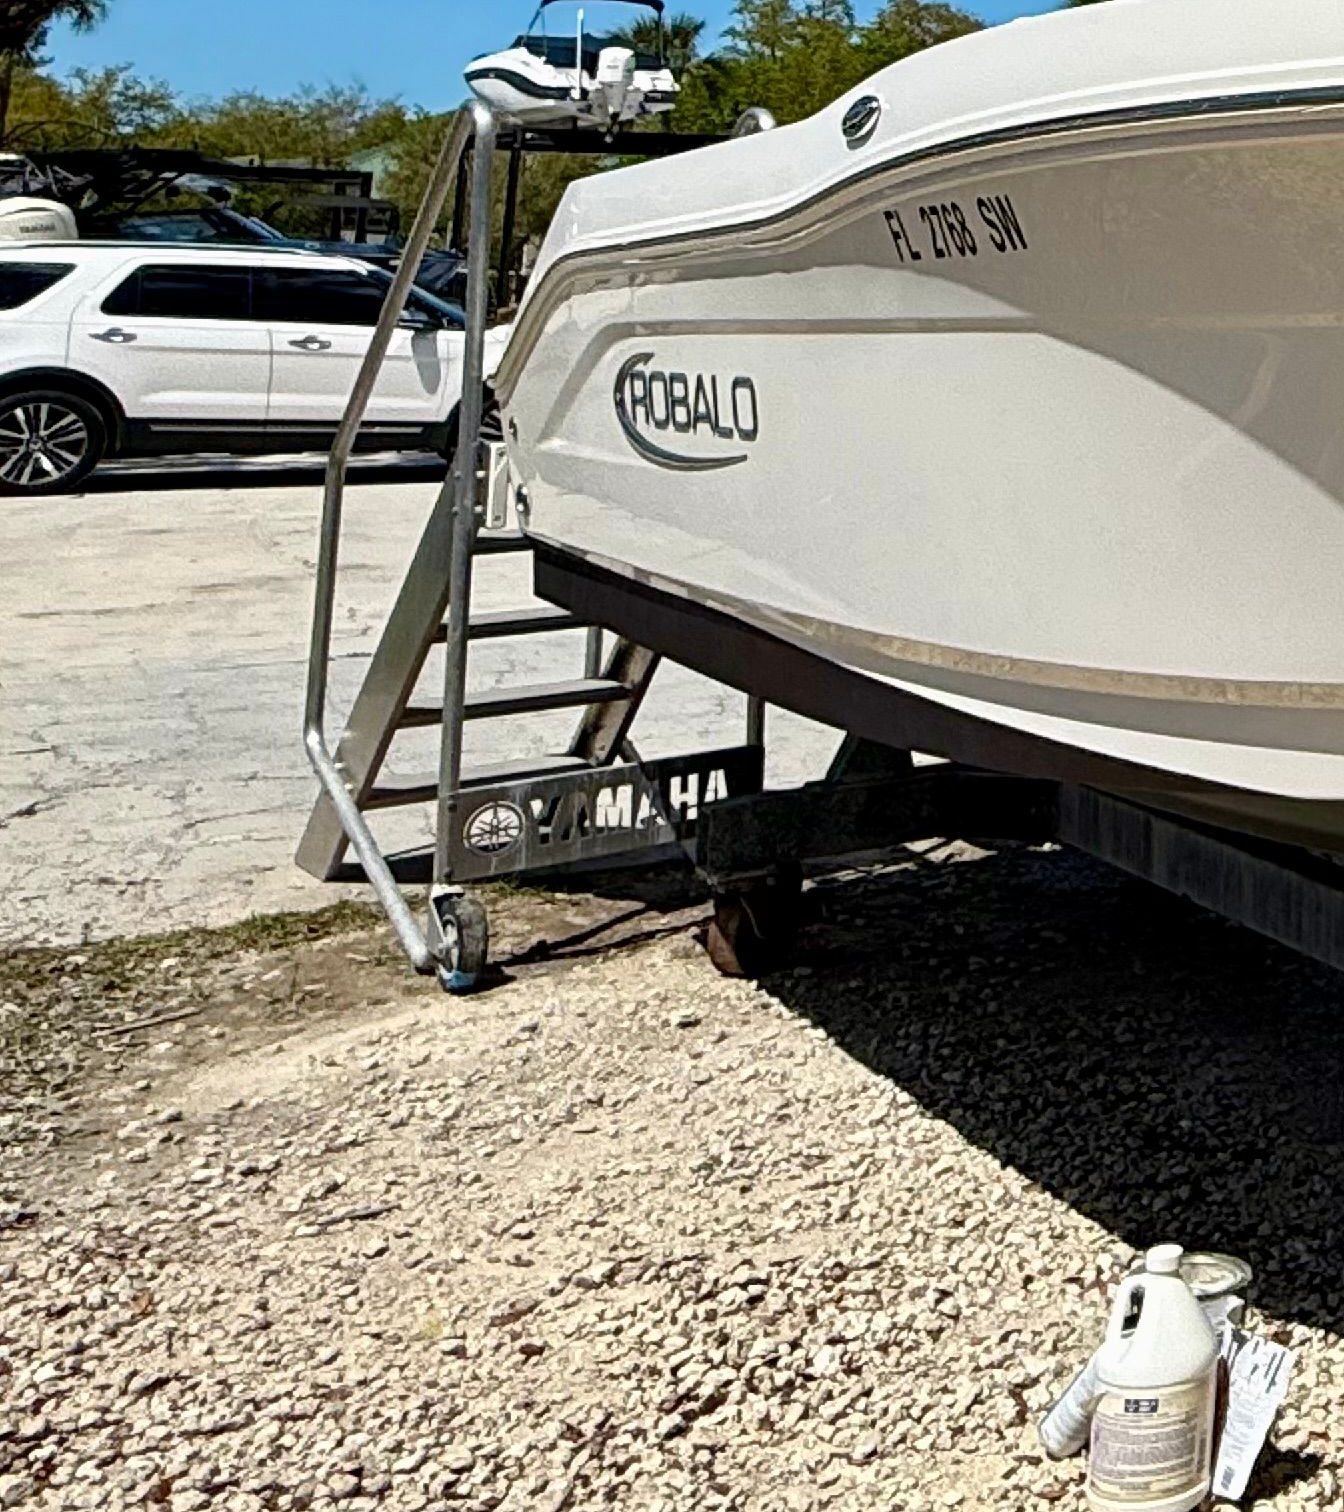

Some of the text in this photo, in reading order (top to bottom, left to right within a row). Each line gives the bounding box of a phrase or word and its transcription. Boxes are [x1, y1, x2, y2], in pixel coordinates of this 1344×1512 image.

[883, 193, 1029, 263] FL 2768 SW
[629, 370, 759, 442] ROBALO
[530, 768, 729, 846] YAMAHA
